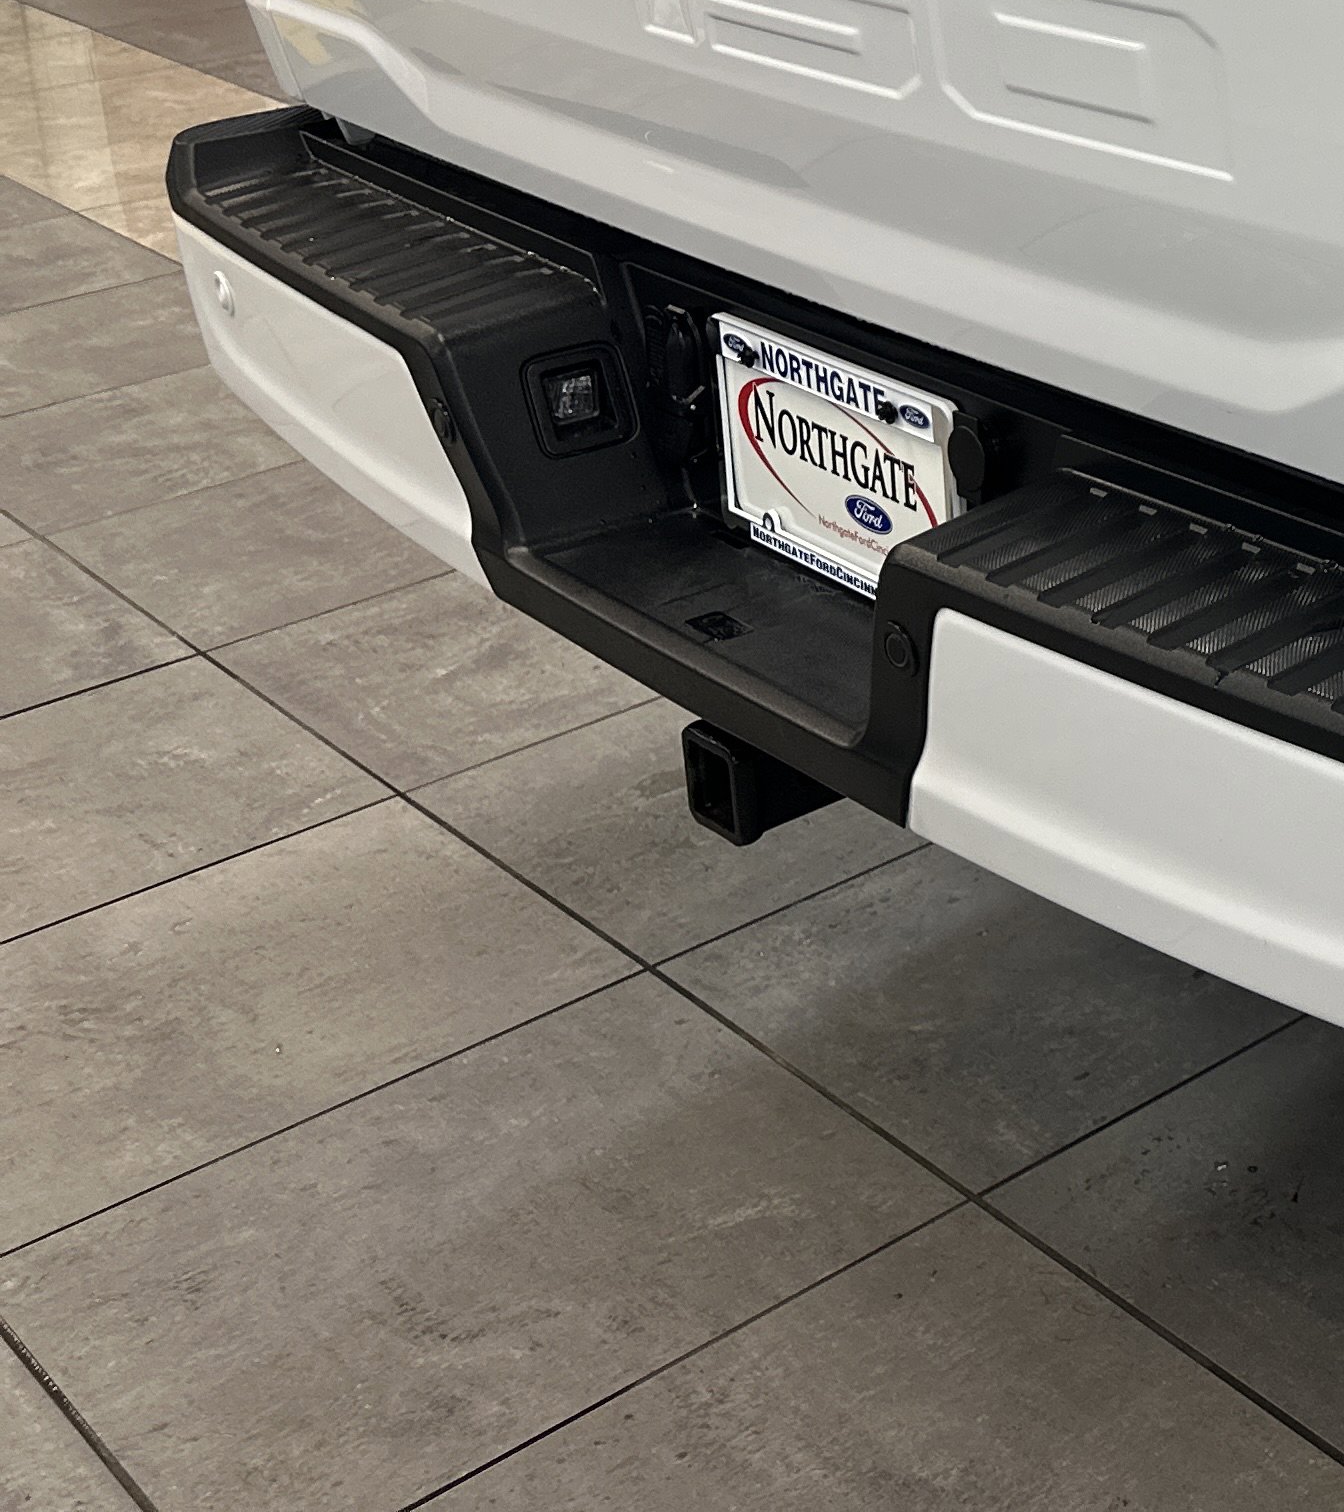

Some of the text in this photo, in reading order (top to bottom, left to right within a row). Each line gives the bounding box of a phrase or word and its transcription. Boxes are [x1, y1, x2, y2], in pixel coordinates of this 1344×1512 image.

[760, 341, 885, 416] NORTHGATE
[752, 383, 918, 512] NORTHGATE
[853, 498, 883, 529] Ford
